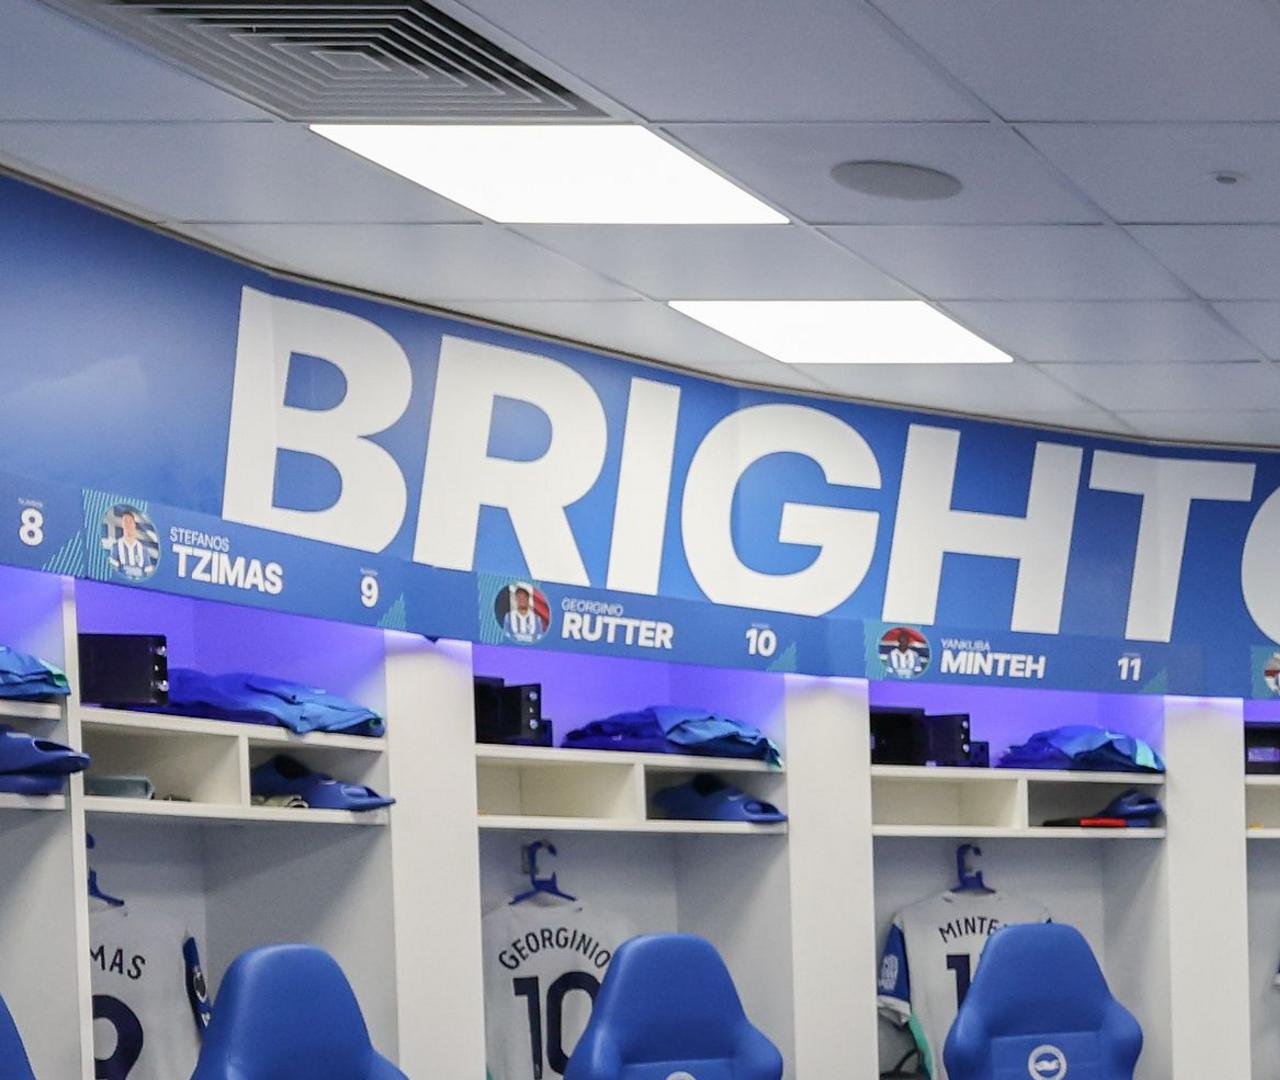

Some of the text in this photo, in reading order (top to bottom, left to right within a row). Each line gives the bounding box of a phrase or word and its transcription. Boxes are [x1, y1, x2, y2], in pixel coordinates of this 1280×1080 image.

[19, 507, 44, 546] 8
[169, 526, 230, 553] STEFANOS
[172, 543, 283, 595] TZIMAS
[360, 575, 379, 608] 9
[561, 611, 674, 650] RUTTER
[746, 627, 777, 657] 10
[940, 649, 1046, 679] MINTEH
[1117, 656, 1142, 681] 11
[939, 916, 1008, 943] MINTE
[498, 927, 611, 971] GEORGINIO
